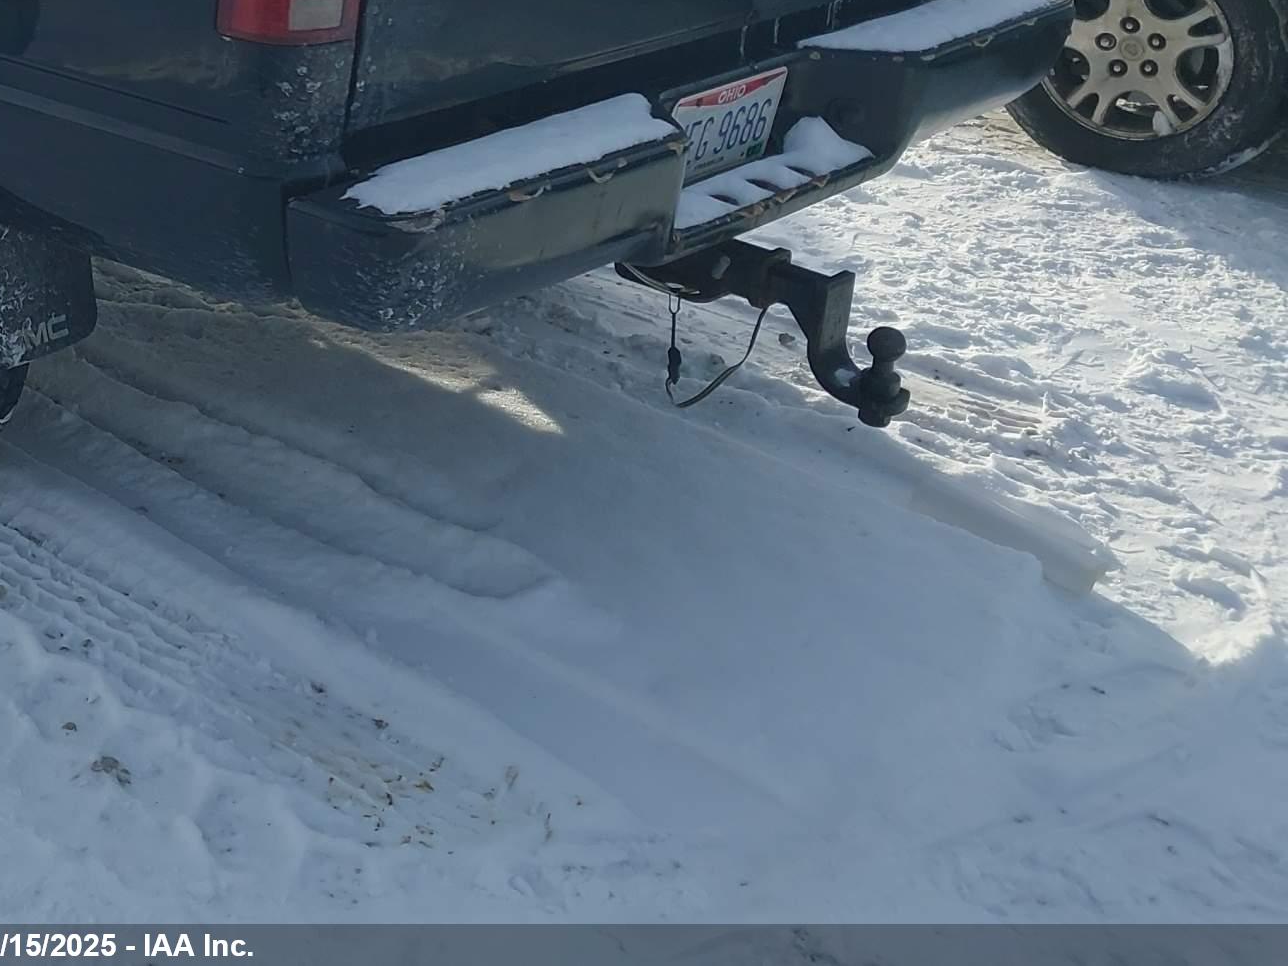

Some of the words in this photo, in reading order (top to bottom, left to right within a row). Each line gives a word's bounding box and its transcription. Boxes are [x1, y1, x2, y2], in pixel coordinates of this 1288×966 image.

[717, 84, 747, 104] OHIO
[713, 98, 772, 154] 9686
[10, 313, 70, 350] MC
